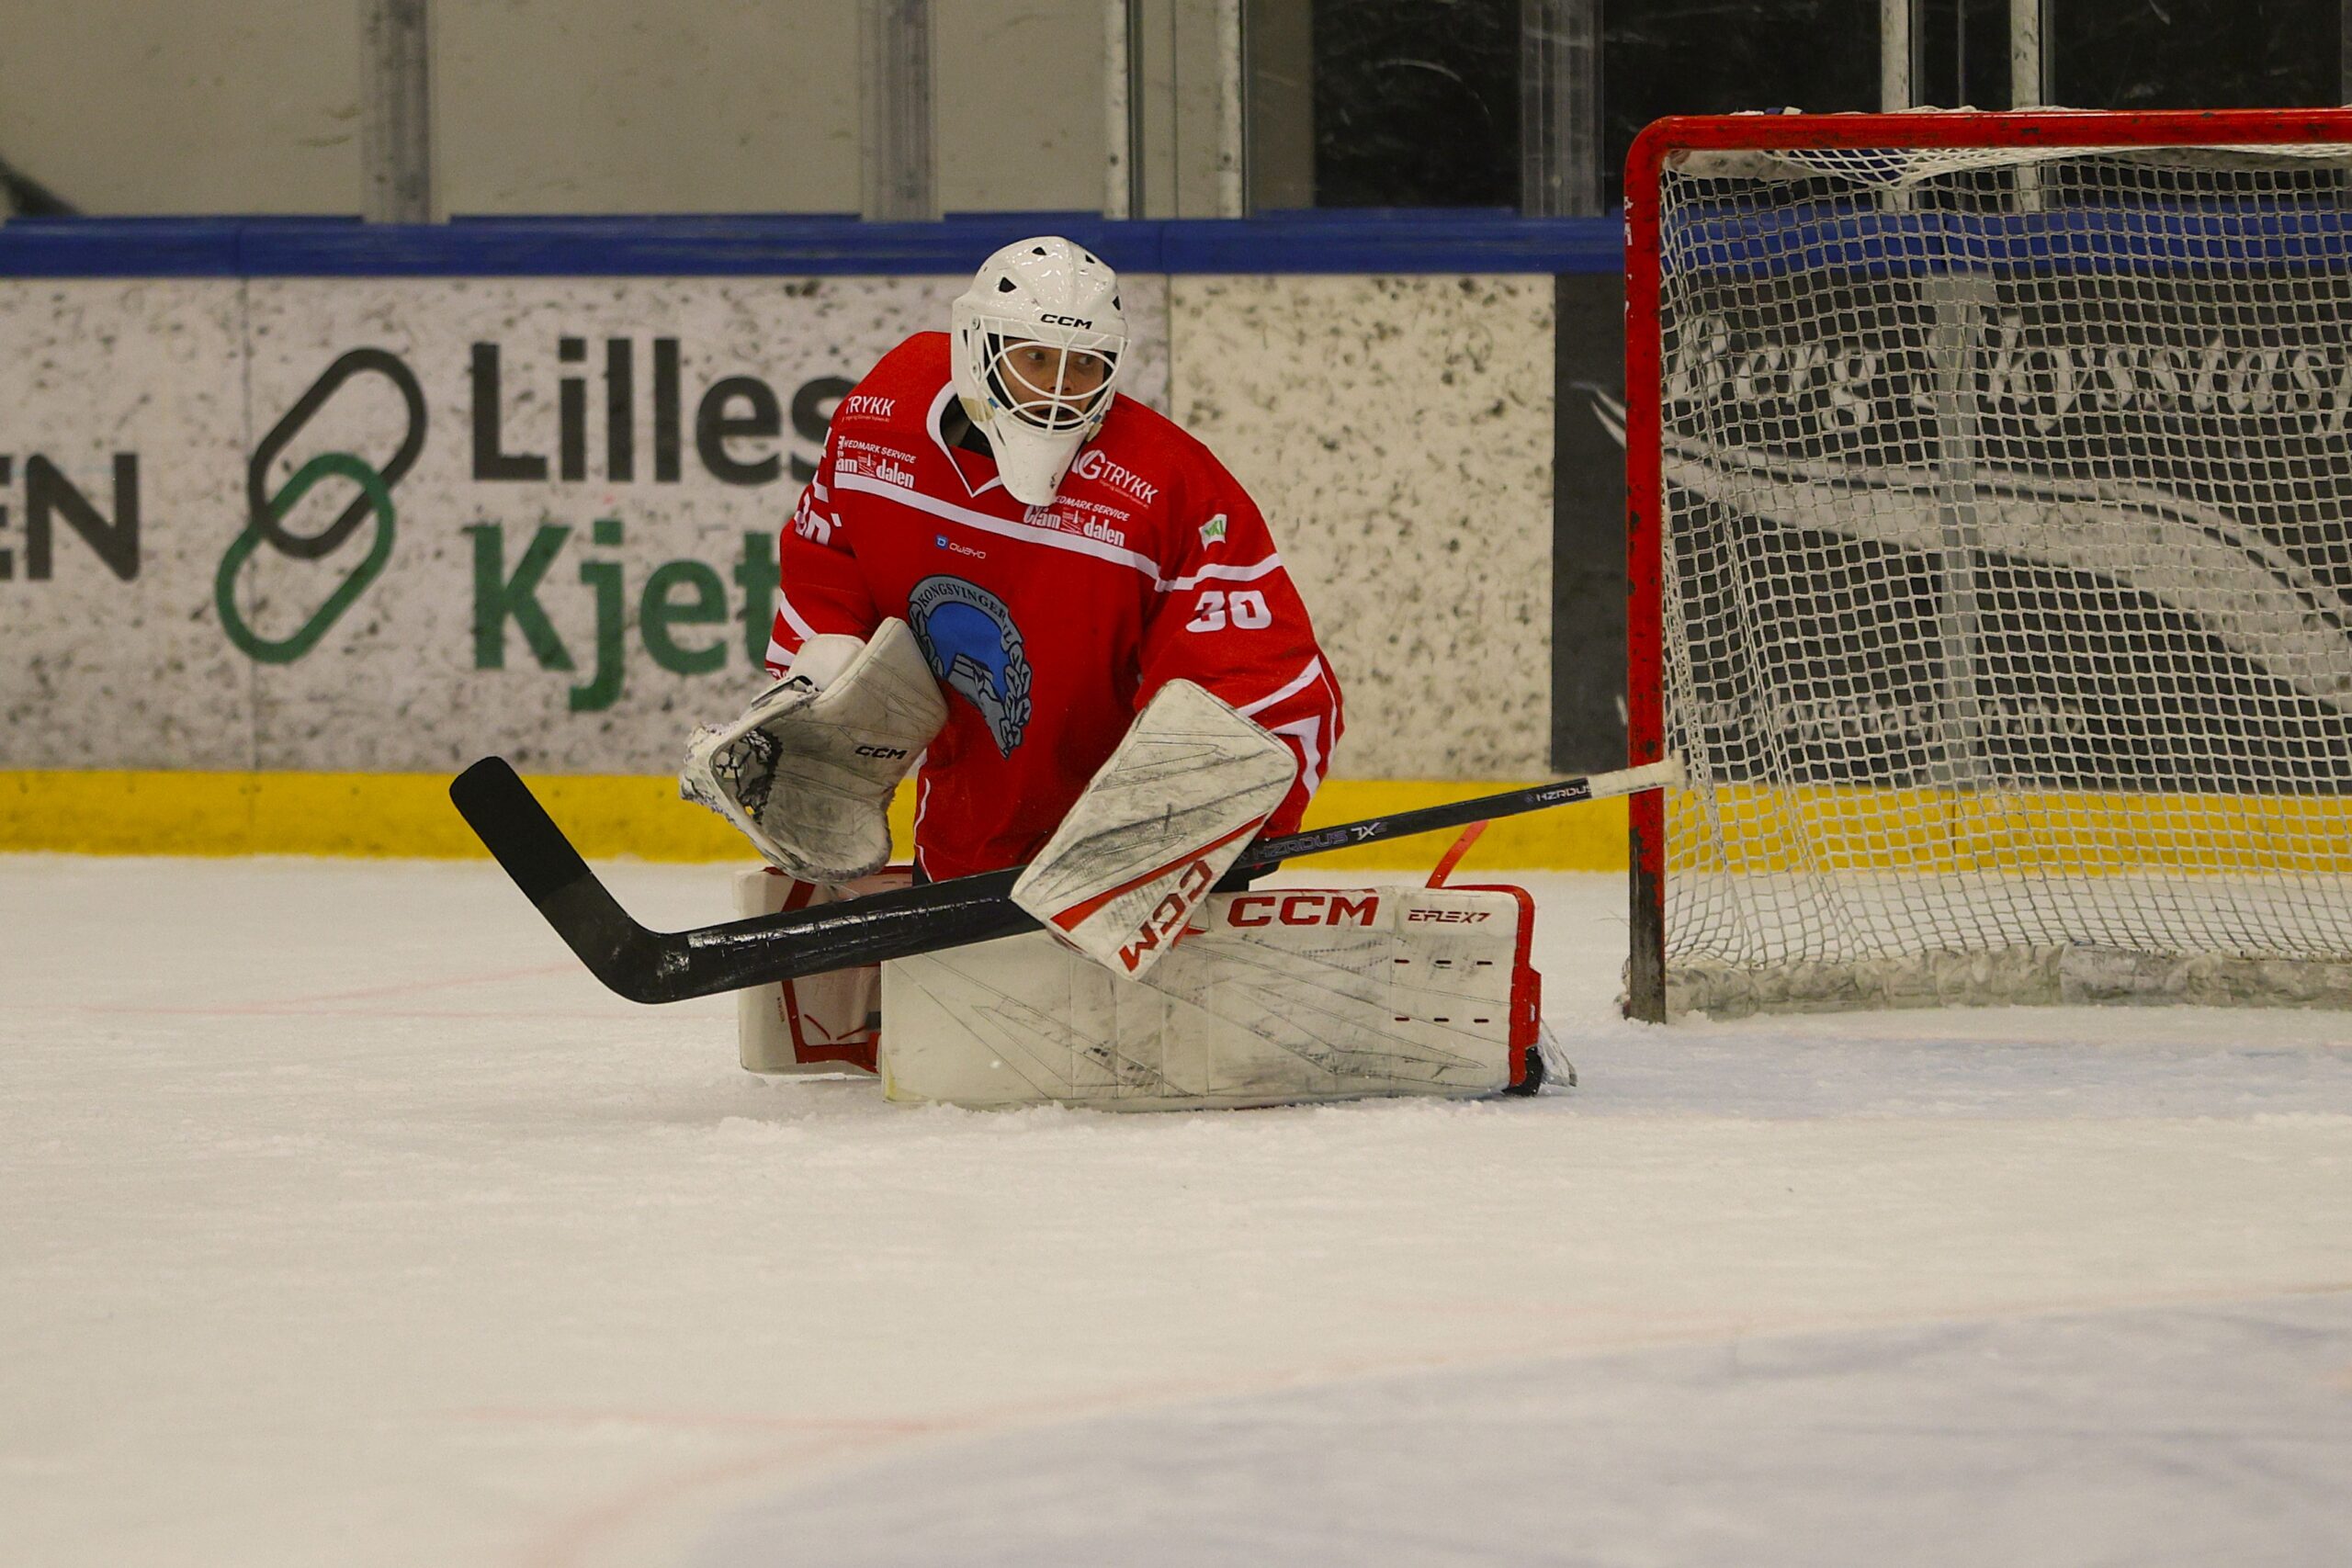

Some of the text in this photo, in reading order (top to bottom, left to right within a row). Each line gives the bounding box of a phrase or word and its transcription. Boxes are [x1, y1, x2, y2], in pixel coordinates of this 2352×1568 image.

[1041, 313, 1093, 330] CCM
[470, 337, 862, 486] Lilles
[880, 446, 916, 464] SERVICE
[876, 458, 915, 489] dalen
[1102, 460, 1159, 504] TRYKK
[0, 453, 140, 581] N
[1057, 495, 1093, 512] EDMARK
[1091, 502, 1131, 522] SERVICE
[1082, 515, 1125, 547] dalen
[918, 583, 1007, 622] KONGSVINGER
[1185, 590, 1272, 633] 30
[854, 745, 908, 761] CCM
[1120, 860, 1213, 973] CCM
[1227, 896, 1380, 928] CCM
